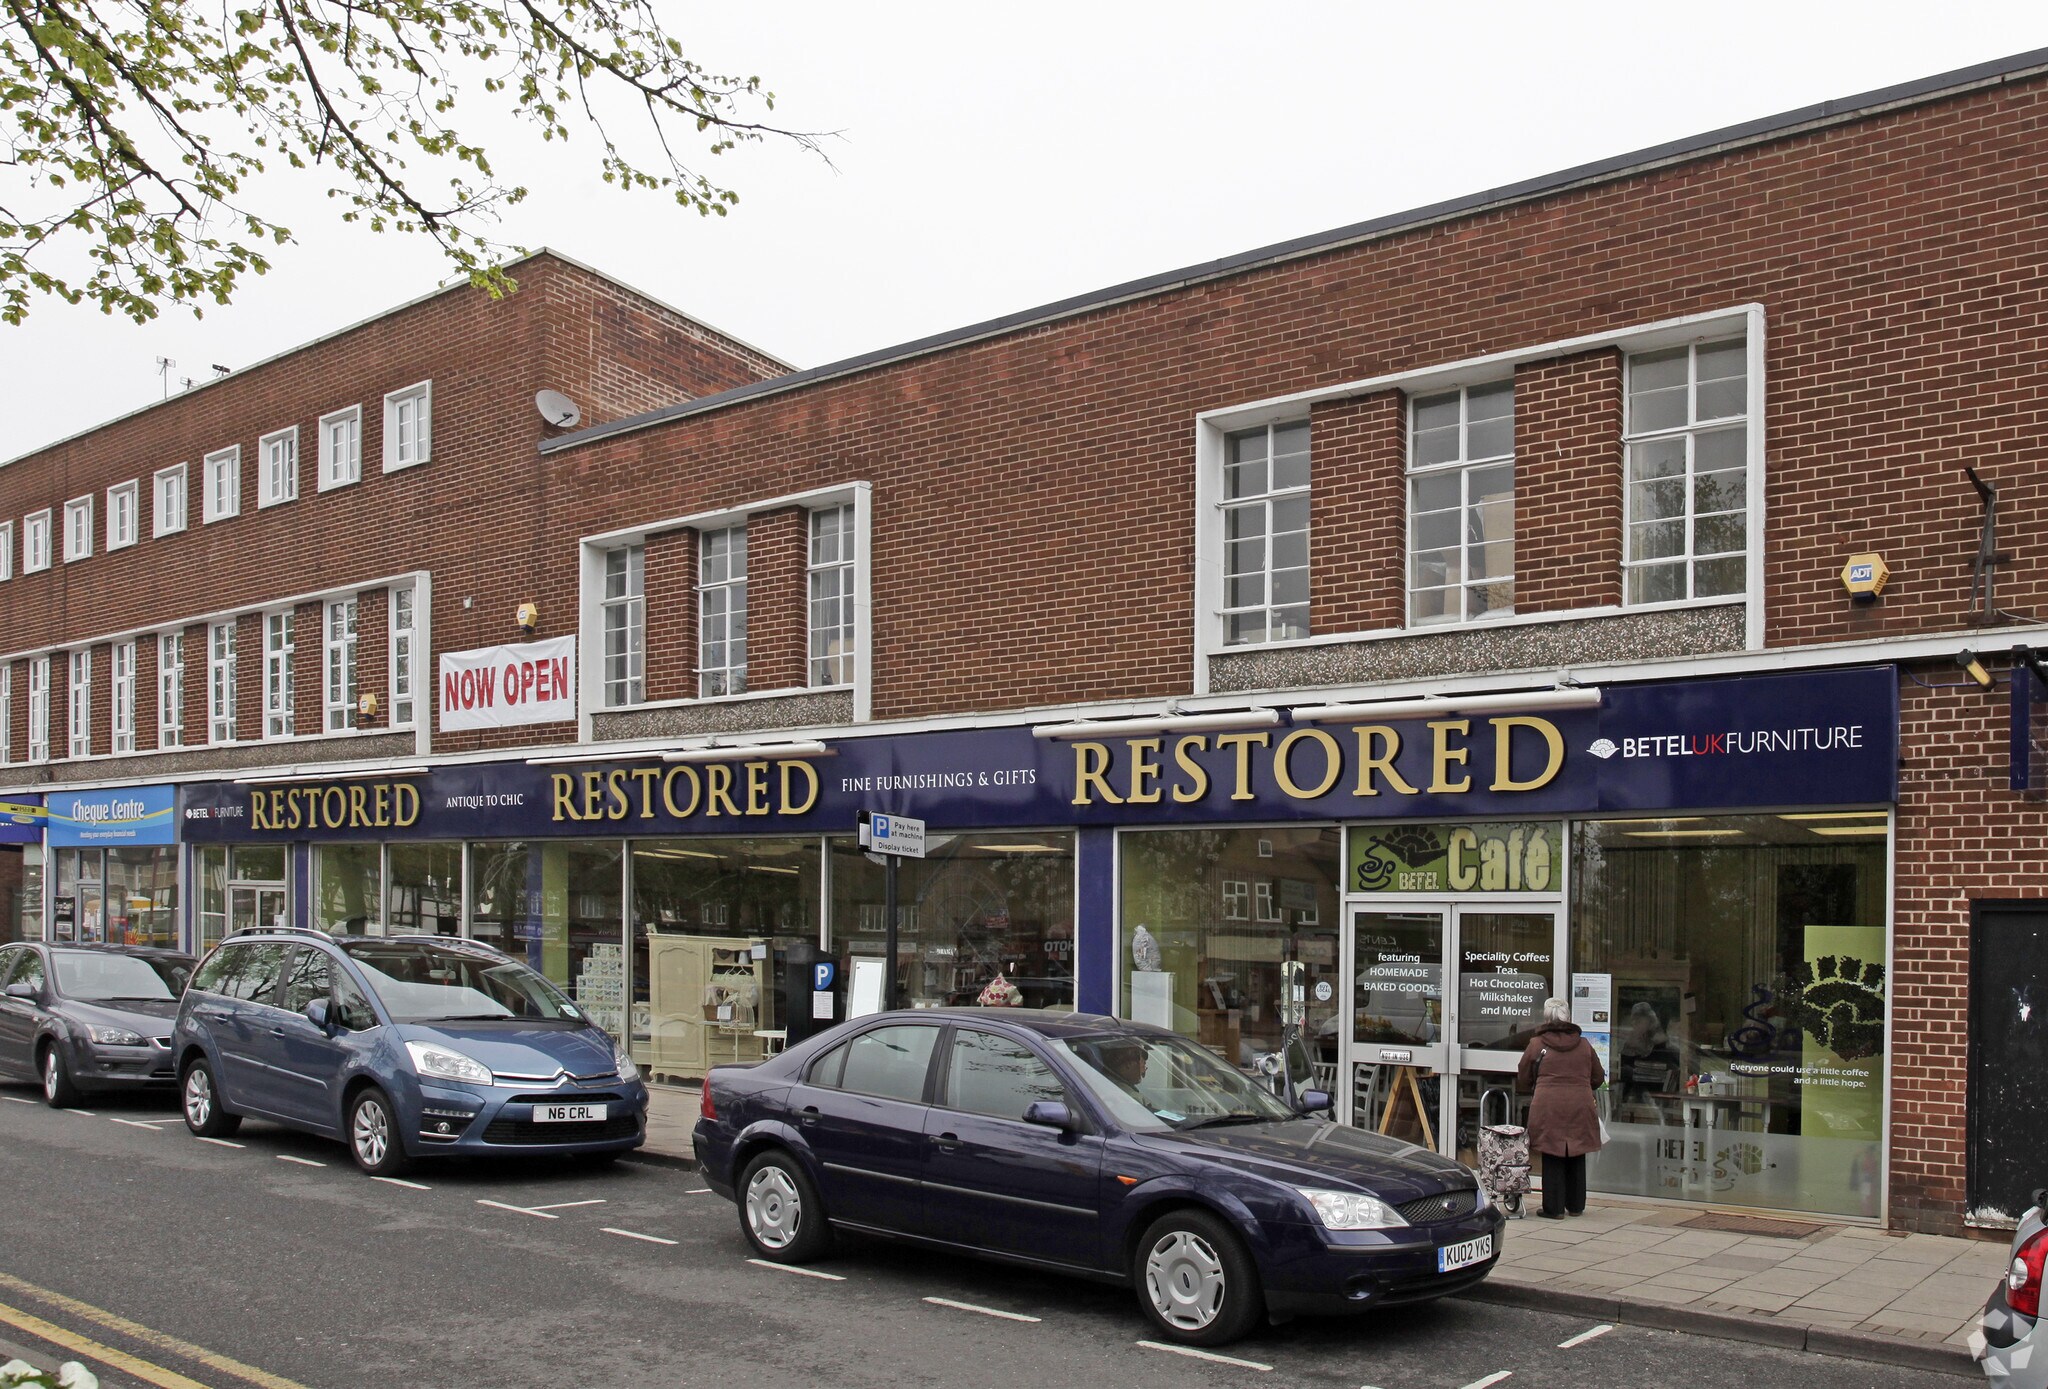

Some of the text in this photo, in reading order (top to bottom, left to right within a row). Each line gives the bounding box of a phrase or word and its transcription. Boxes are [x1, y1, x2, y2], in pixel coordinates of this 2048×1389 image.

[1850, 567, 1873, 579] ADT
[445, 656, 568, 712] NOW OPEN
[1071, 716, 1565, 805] RESTORED
[842, 769, 1036, 792] FINE FURNISHINGS & GIFTS
[551, 760, 819, 821] RESTORED
[250, 783, 421, 830] RESTORED
[446, 793, 524, 809] ANTIQUE TO CHIC
[72, 799, 145, 827] Cheque Centre
[876, 817, 888, 836] P
[894, 821, 920, 831] Pay here
[899, 832, 923, 840] machine
[878, 841, 919, 854] Display ticket
[1448, 826, 1551, 892] Café
[1399, 871, 1440, 890] BETEL
[1377, 952, 1421, 965] featuring
[1464, 951, 1550, 964] Speciality Coffees
[817, 965, 829, 986] P
[1369, 967, 1429, 977] HOMEMADE
[1495, 965, 1518, 975] Teas
[1363, 982, 1435, 993] BAKED GOODS
[1469, 978, 1545, 990] Hot Chocolates
[1479, 991, 1533, 1003] Milkshakes
[1480, 1006, 1531, 1016] and More!
[1730, 1062, 1769, 1073] Everyone
[1770, 1064, 1795, 1073] could
[1796, 1066, 1811, 1074] use
[1820, 1066, 1840, 1075] little
[1841, 1068, 1869, 1077] coffee
[1793, 1076, 1811, 1085] and
[1820, 1077, 1839, 1086] little
[1841, 1078, 1867, 1089] hope.
[548, 1106, 594, 1120] N6 CRL
[1446, 1236, 1491, 1266] KU02 YKS
